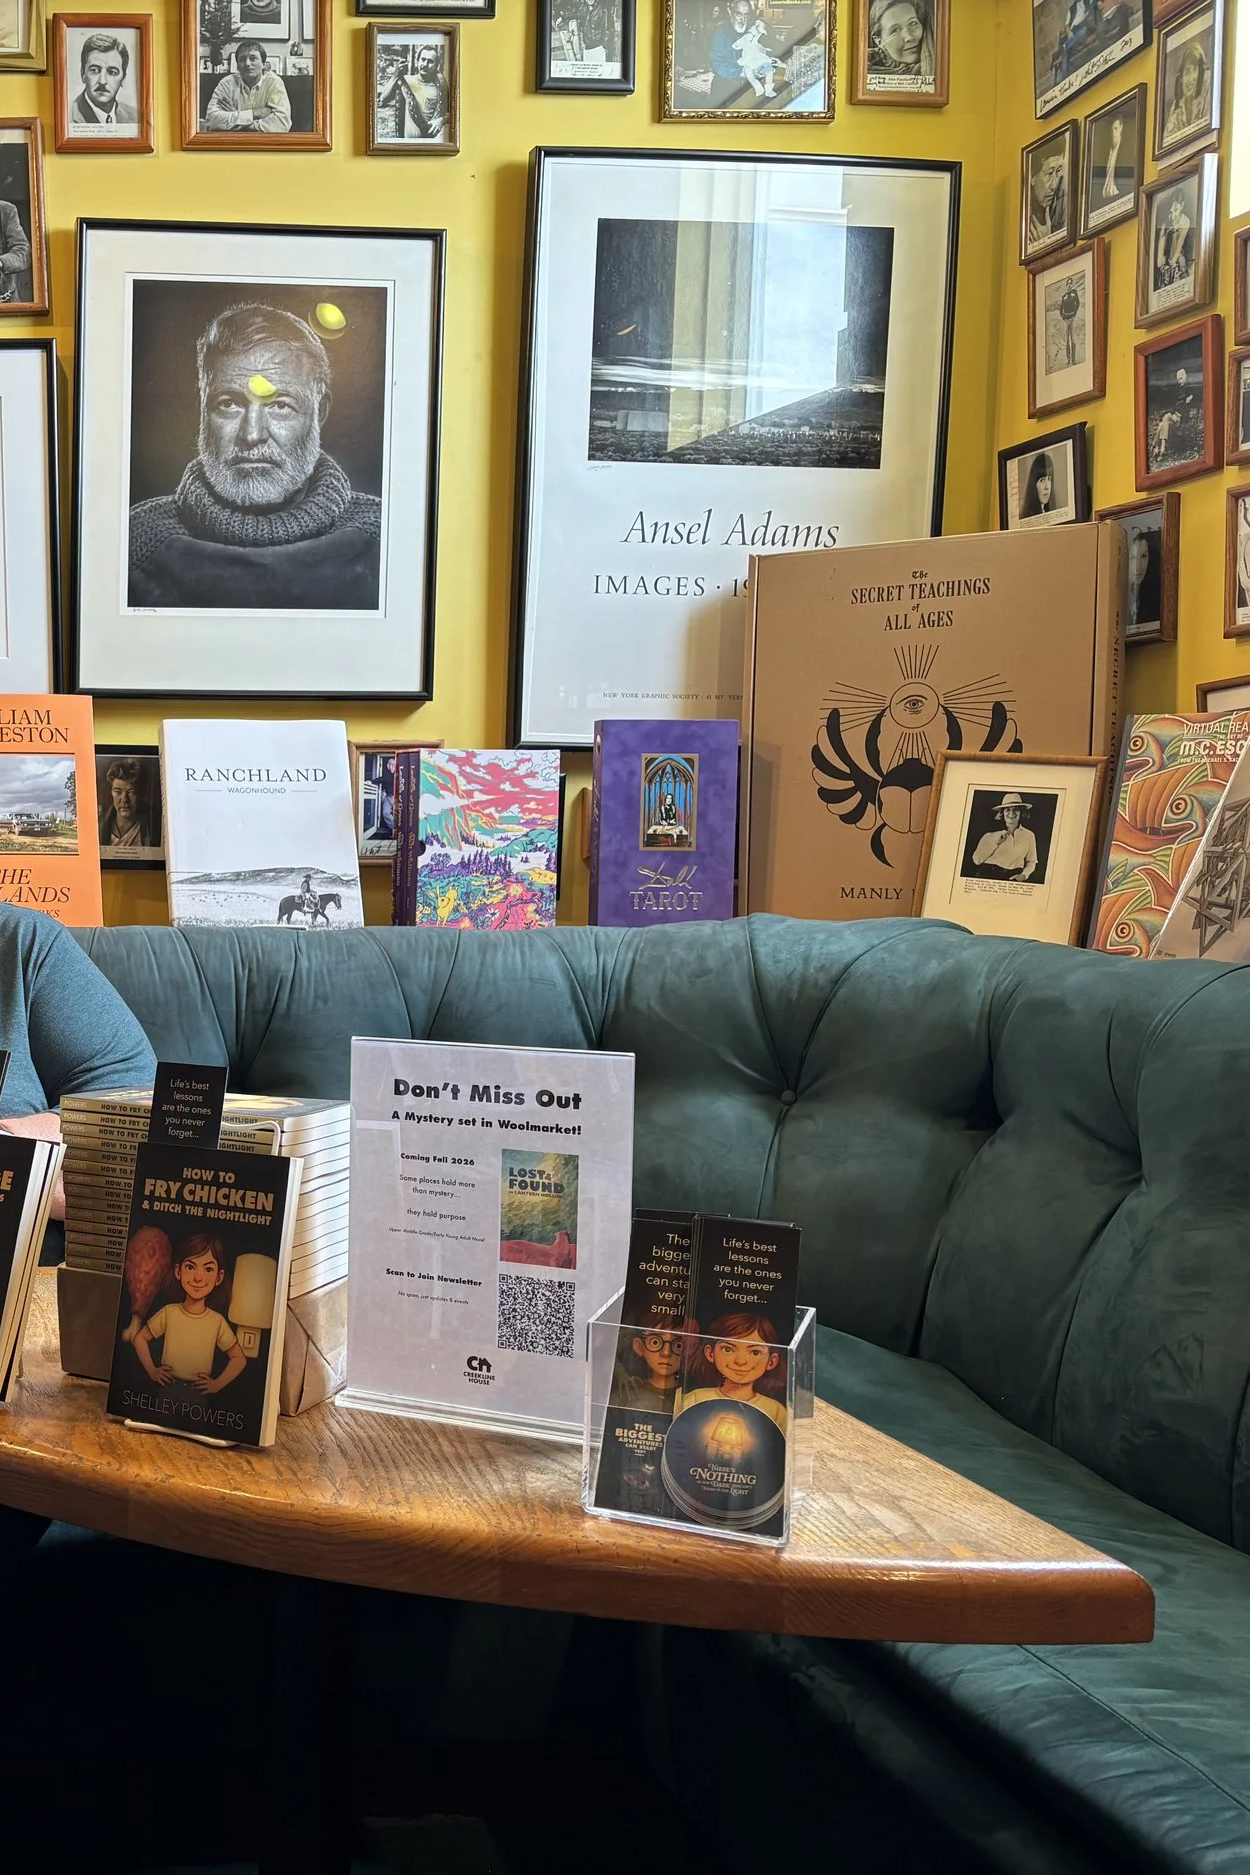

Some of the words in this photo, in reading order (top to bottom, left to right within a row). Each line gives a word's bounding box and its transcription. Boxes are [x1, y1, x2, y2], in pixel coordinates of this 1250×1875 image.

[620, 508, 713, 546] Ansel
[721, 510, 839, 548] Adams
[593, 574, 706, 597] IMAGES
[851, 583, 904, 605] SECRET
[908, 577, 991, 601] TEACHINGS
[912, 603, 920, 613] of
[884, 613, 911, 631] ALL
[917, 610, 954, 629] AGES
[185, 766, 327, 784] RANCHLAND
[227, 787, 286, 795] WAGONHOUND
[629, 892, 703, 910] TAROT
[840, 887, 903, 900] MANLY
[192, 1080, 210, 1091] best
[173, 1091, 203, 1102] lessons
[469, 1084, 525, 1106] Miss
[535, 1089, 582, 1110] Out
[162, 1103, 174, 1111] are
[176, 1103, 190, 1113] the
[192, 1107, 212, 1115] ones
[165, 1116, 179, 1125] you
[181, 1118, 205, 1127] never
[391, 1111, 401, 1120] A
[404, 1112, 454, 1128] Mystery
[458, 1116, 477, 1127] set
[481, 1117, 493, 1128] in
[498, 1119, 582, 1136] Woolmarket!
[400, 1153, 430, 1164] Coming
[432, 1155, 448, 1164] Fall
[451, 1157, 475, 1166] 2026
[182, 1167, 216, 1182] HOW
[218, 1170, 235, 1184] TO
[399, 1174, 417, 1183] Some
[419, 1175, 440, 1186] places
[441, 1177, 456, 1187] hold
[458, 1181, 475, 1189] more
[412, 1187, 427, 1195] than
[509, 1179, 565, 1194] FOUND
[143, 1178, 182, 1199] FRY
[182, 1182, 274, 1213] CHICKEN
[142, 1200, 150, 1211] &
[153, 1202, 183, 1214] DITCH
[185, 1204, 204, 1216] THE
[206, 1208, 272, 1226] NIGHTLIGHT
[406, 1208, 421, 1217] they
[422, 1209, 438, 1218] hold
[439, 1213, 466, 1222] purpose
[752, 1241, 777, 1253] best
[728, 1252, 769, 1265] lessons
[386, 1268, 405, 1277] Scan
[417, 1271, 434, 1281] Join
[437, 1275, 482, 1287] Newsletter
[713, 1264, 731, 1273] are
[733, 1264, 751, 1275] the
[754, 1269, 782, 1280] ones
[718, 1276, 739, 1288] you
[742, 1280, 774, 1292] never
[463, 1371, 495, 1381] CREEKLINE
[468, 1377, 490, 1386] HOUSE
[122, 1389, 179, 1415] SHELLEY
[180, 1402, 245, 1430] POWERS
[689, 1466, 757, 1485] NOTHING
